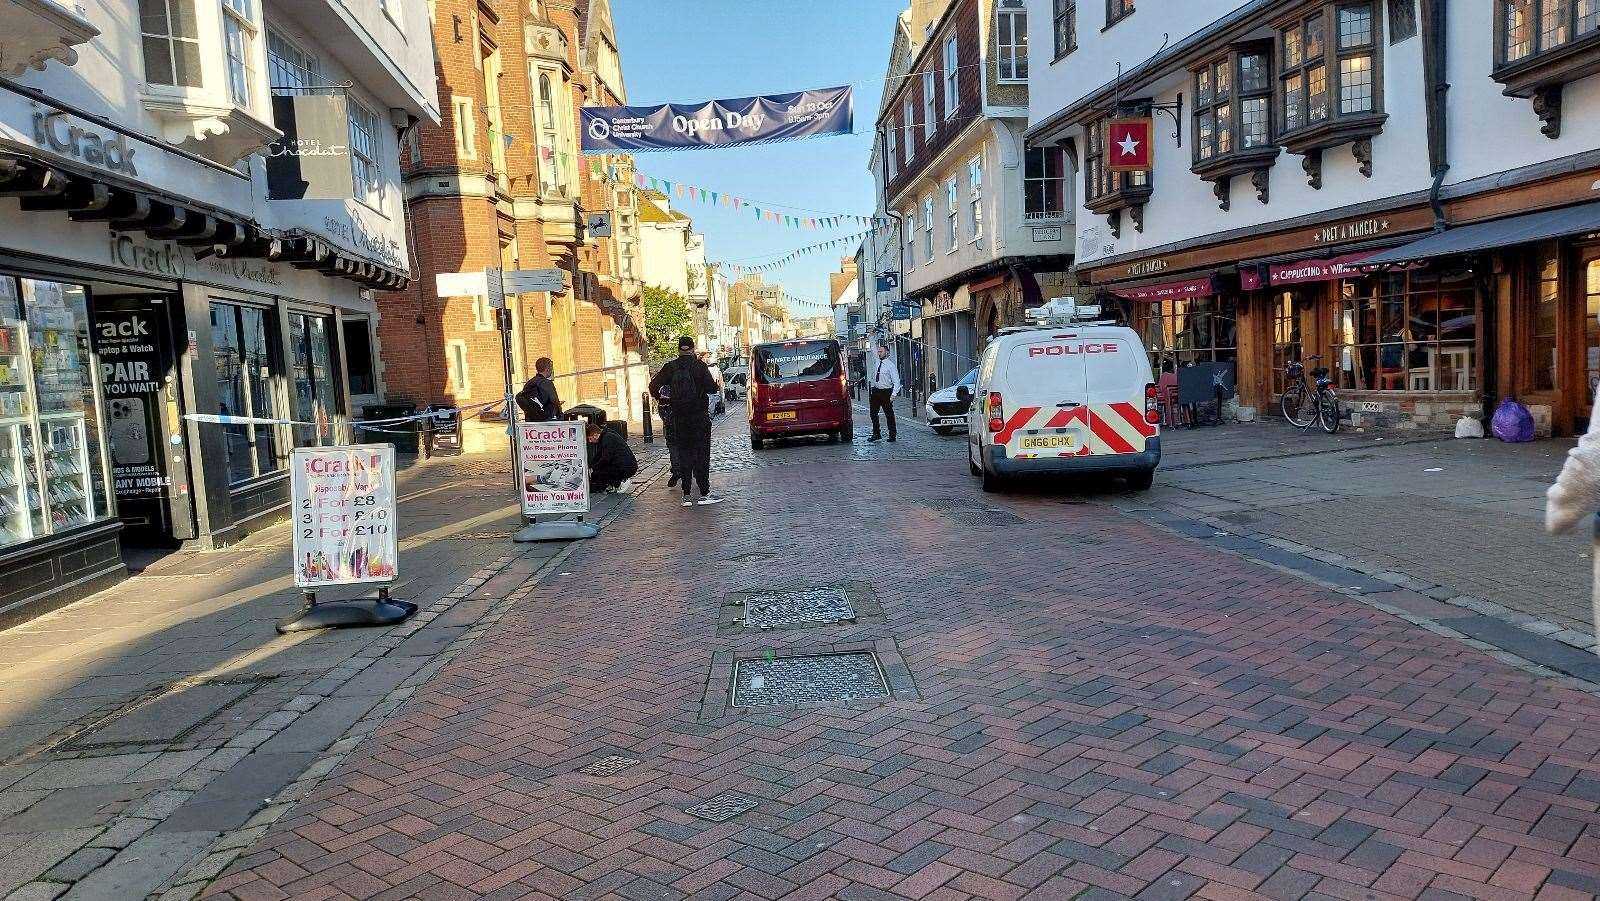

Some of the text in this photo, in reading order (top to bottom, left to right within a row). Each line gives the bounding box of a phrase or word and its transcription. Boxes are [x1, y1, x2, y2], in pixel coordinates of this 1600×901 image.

[672, 111, 766, 136] Open Day
[32, 110, 139, 176] iCrack
[1322, 219, 1379, 243] PRET A MANGER
[110, 231, 182, 278] iCrack
[1280, 266, 1321, 280] CAPPUCCINO
[129, 344, 154, 353] Watch
[1028, 343, 1118, 358] POLICE
[766, 353, 828, 364] PRIVATE AMBULANCE
[101, 361, 150, 383] PAIR
[104, 381, 160, 394] YOU WAIT!
[525, 427, 566, 440] iCrack
[1024, 435, 1070, 447] GN66 CHX
[116, 476, 171, 489] ANY MOBILE
[302, 495, 376, 509] 2 For £8
[526, 491, 585, 502] While You Wait
[302, 513, 313, 524] 3
[319, 512, 350, 523] For
[303, 524, 388, 539] 2 For £10
